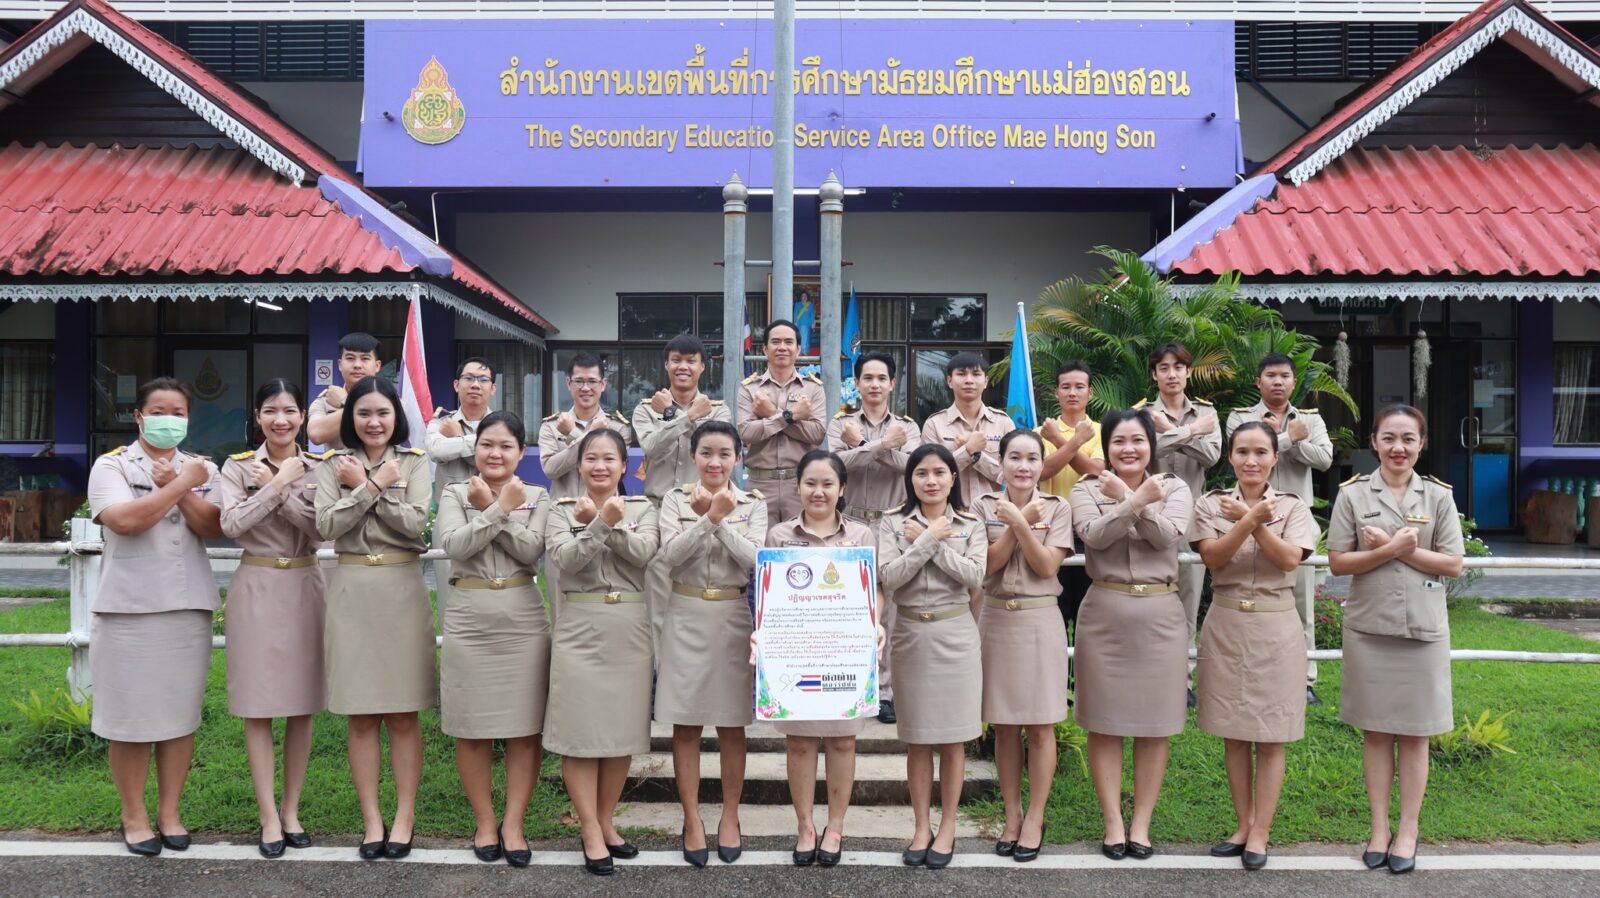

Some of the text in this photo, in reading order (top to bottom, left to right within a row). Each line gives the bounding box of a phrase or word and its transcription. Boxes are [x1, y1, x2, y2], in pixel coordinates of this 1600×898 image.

[525, 123, 1157, 155] The Secondary Educatio Service Area Office Mae Hong Son
